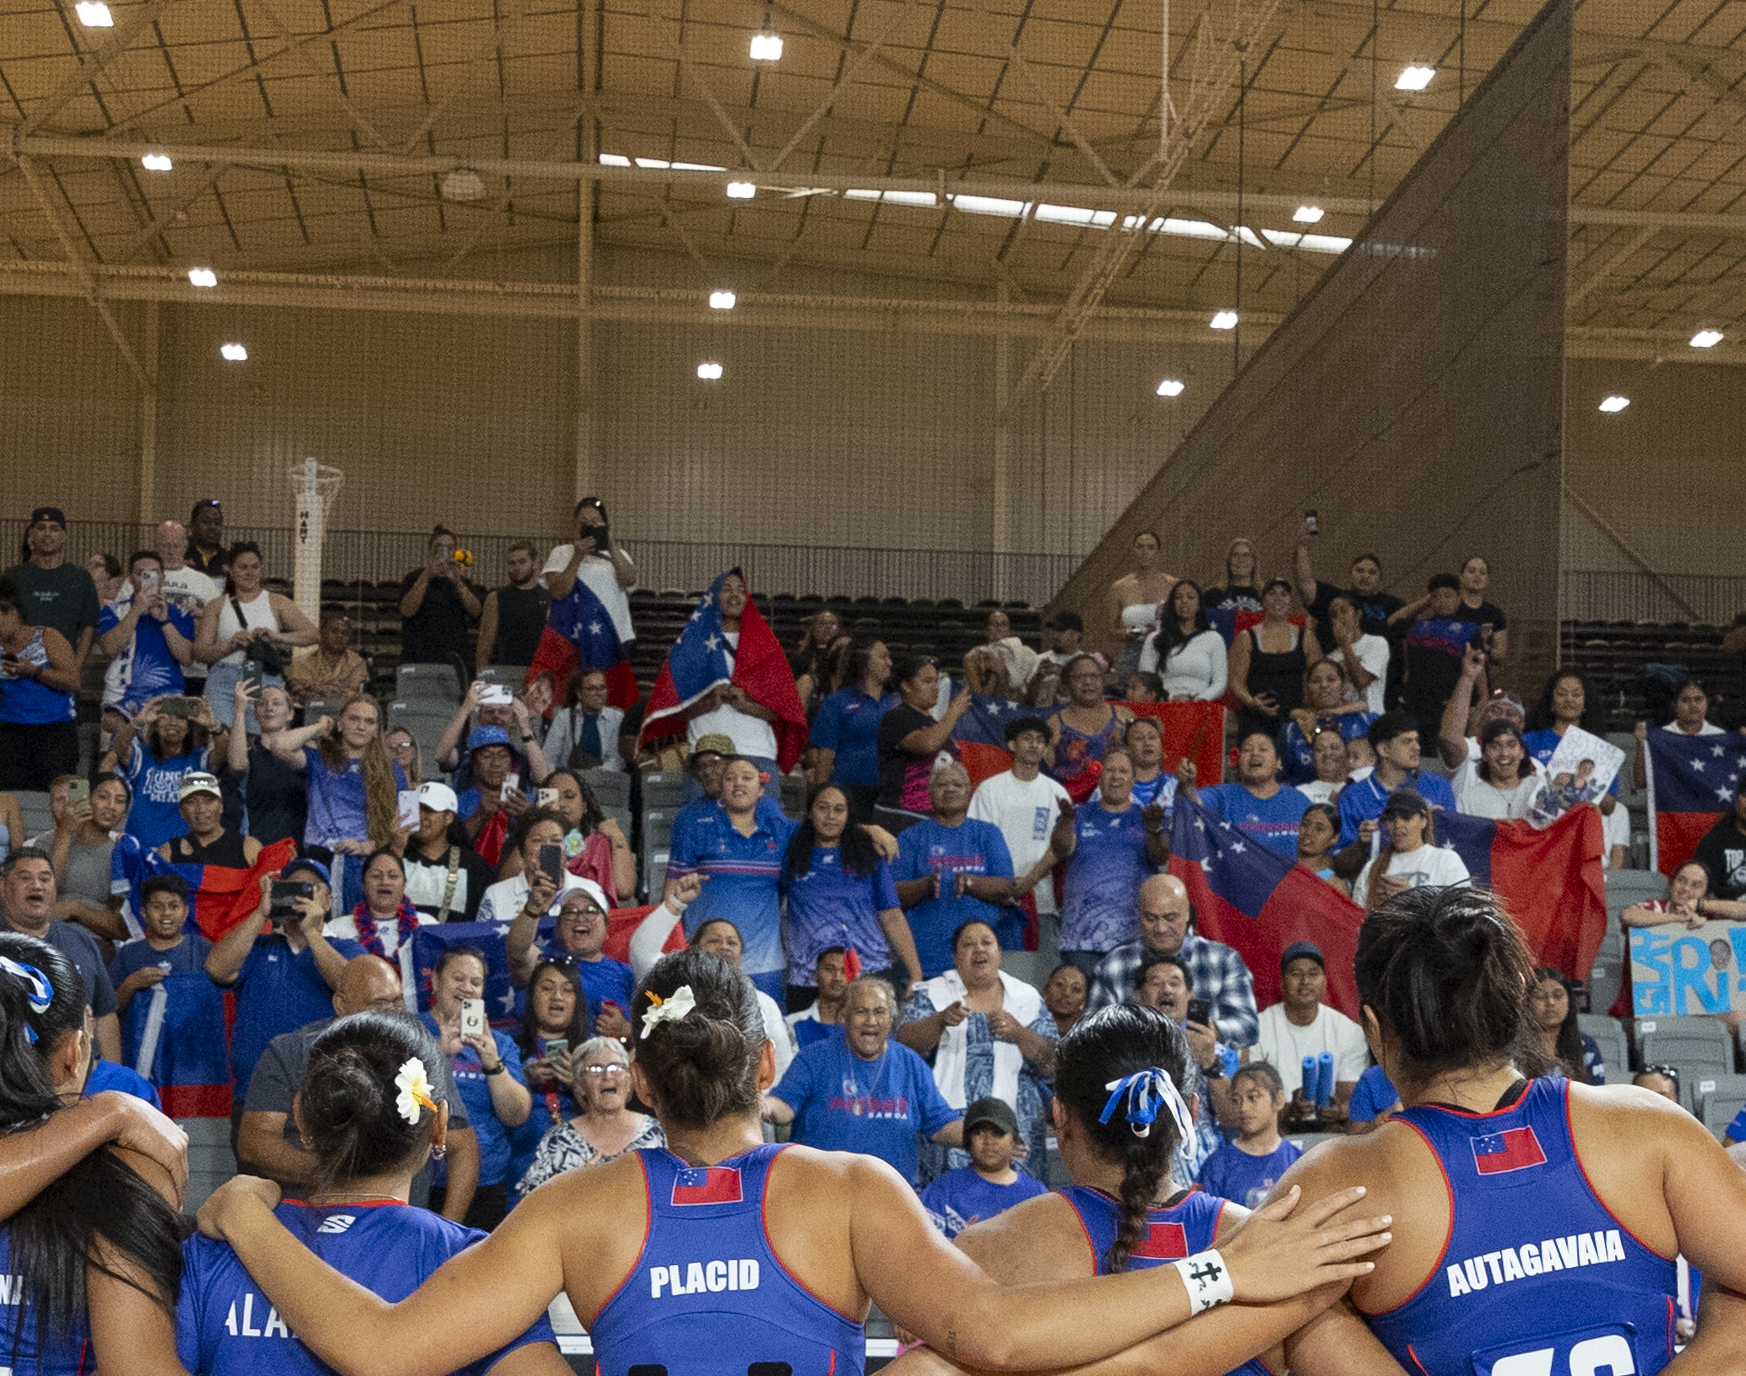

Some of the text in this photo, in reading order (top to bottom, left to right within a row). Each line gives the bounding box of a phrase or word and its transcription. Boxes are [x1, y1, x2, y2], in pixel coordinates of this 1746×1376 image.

[867, 1111, 908, 1121] SAMOA
[650, 1259, 760, 1298] PLACID
[1446, 1229, 1626, 1297] AUTAGAVAIA
